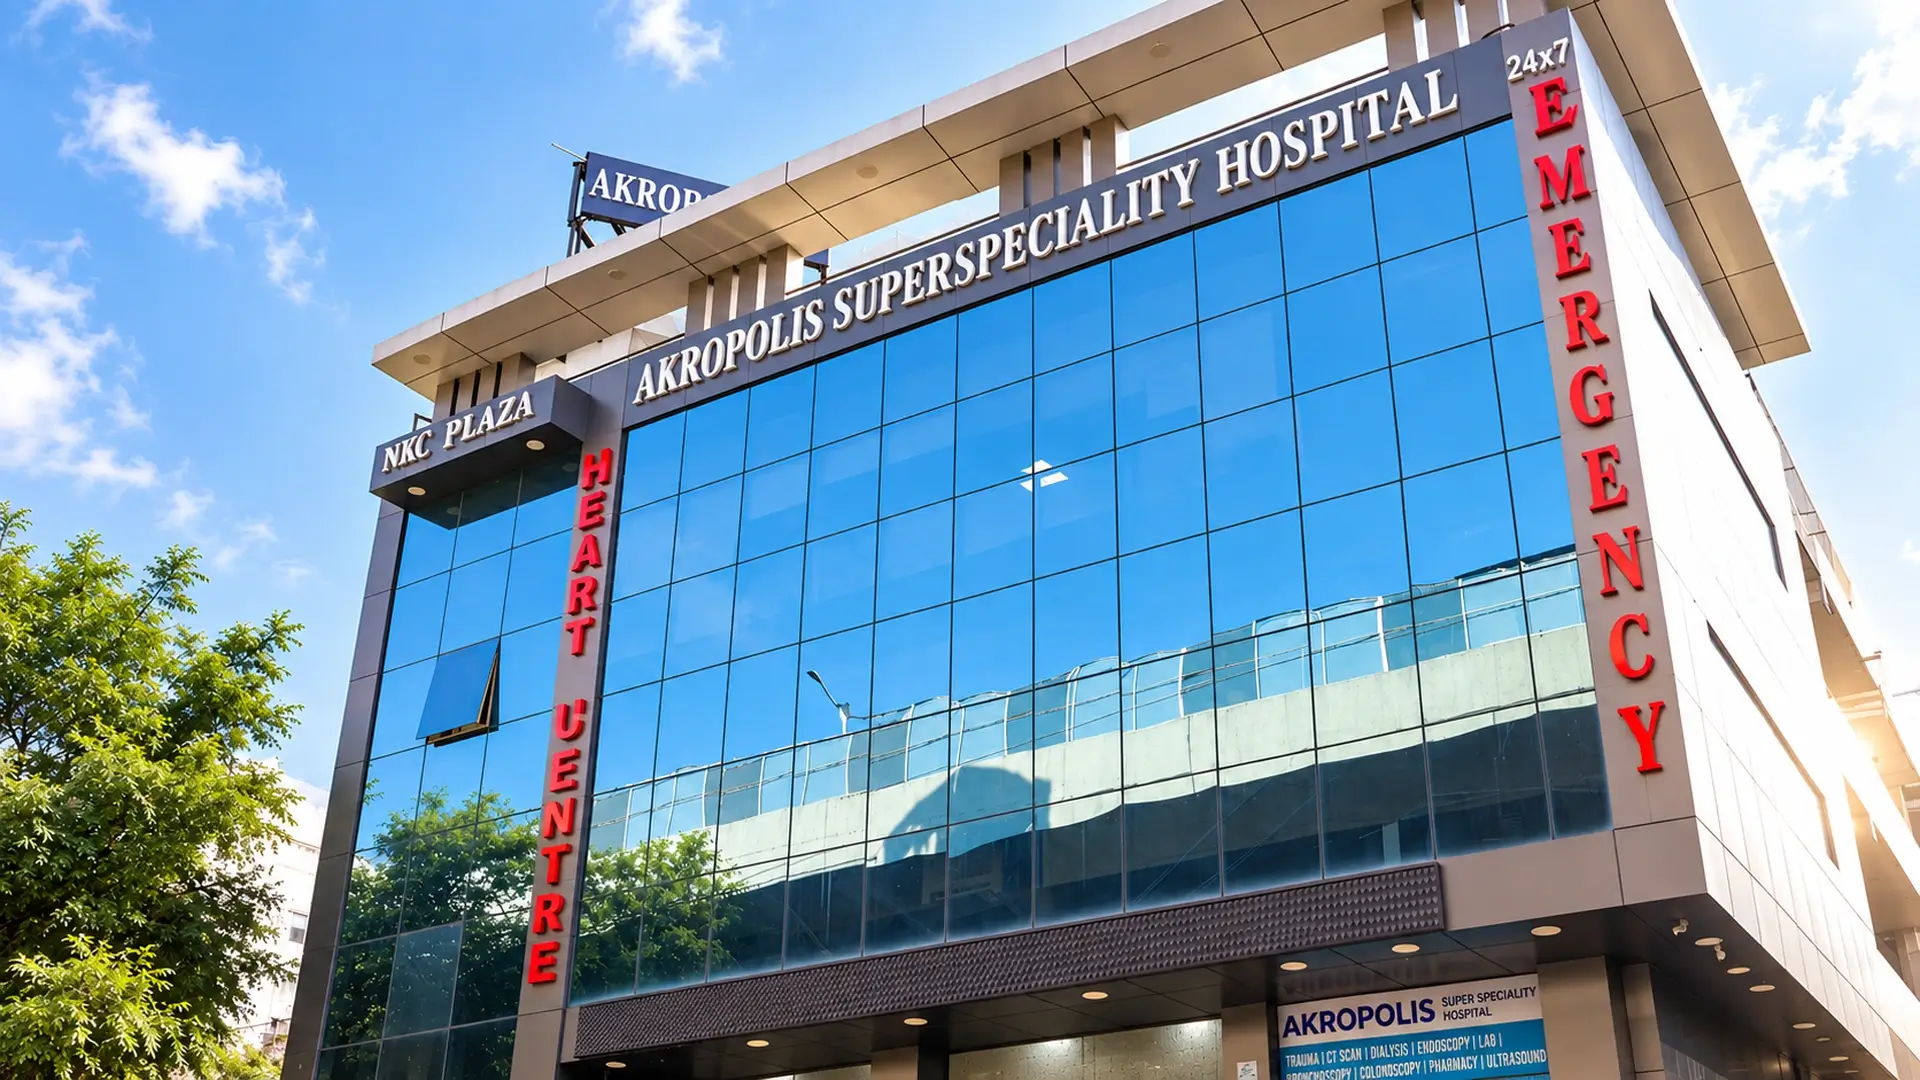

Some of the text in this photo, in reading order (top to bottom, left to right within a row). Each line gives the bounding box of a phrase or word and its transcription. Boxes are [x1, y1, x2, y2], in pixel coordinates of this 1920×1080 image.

[1506, 37, 1570, 83] 24x7
[588, 168, 712, 214] AKROP
[632, 68, 1459, 406] AKROPOLIS SUPERSPECIALITY HOSPITAL
[381, 391, 536, 473] NKC PLAZA
[1528, 76, 1664, 771] EMERGENCY
[565, 448, 612, 654] HEART
[1282, 986, 1536, 1038] AKROPOLIS SUPER SPECIALITY
[1443, 1007, 1493, 1021] HOSPITAL
[1285, 1033, 1497, 1068] TRAUMA CT SCAN DIALYSIS ENDOSCOPY LAB
[1360, 1060, 1421, 1080] COLONOSCOPY
[1429, 1055, 1478, 1073] PHARMACY
[1486, 1048, 1547, 1068] ULTRASOUND
